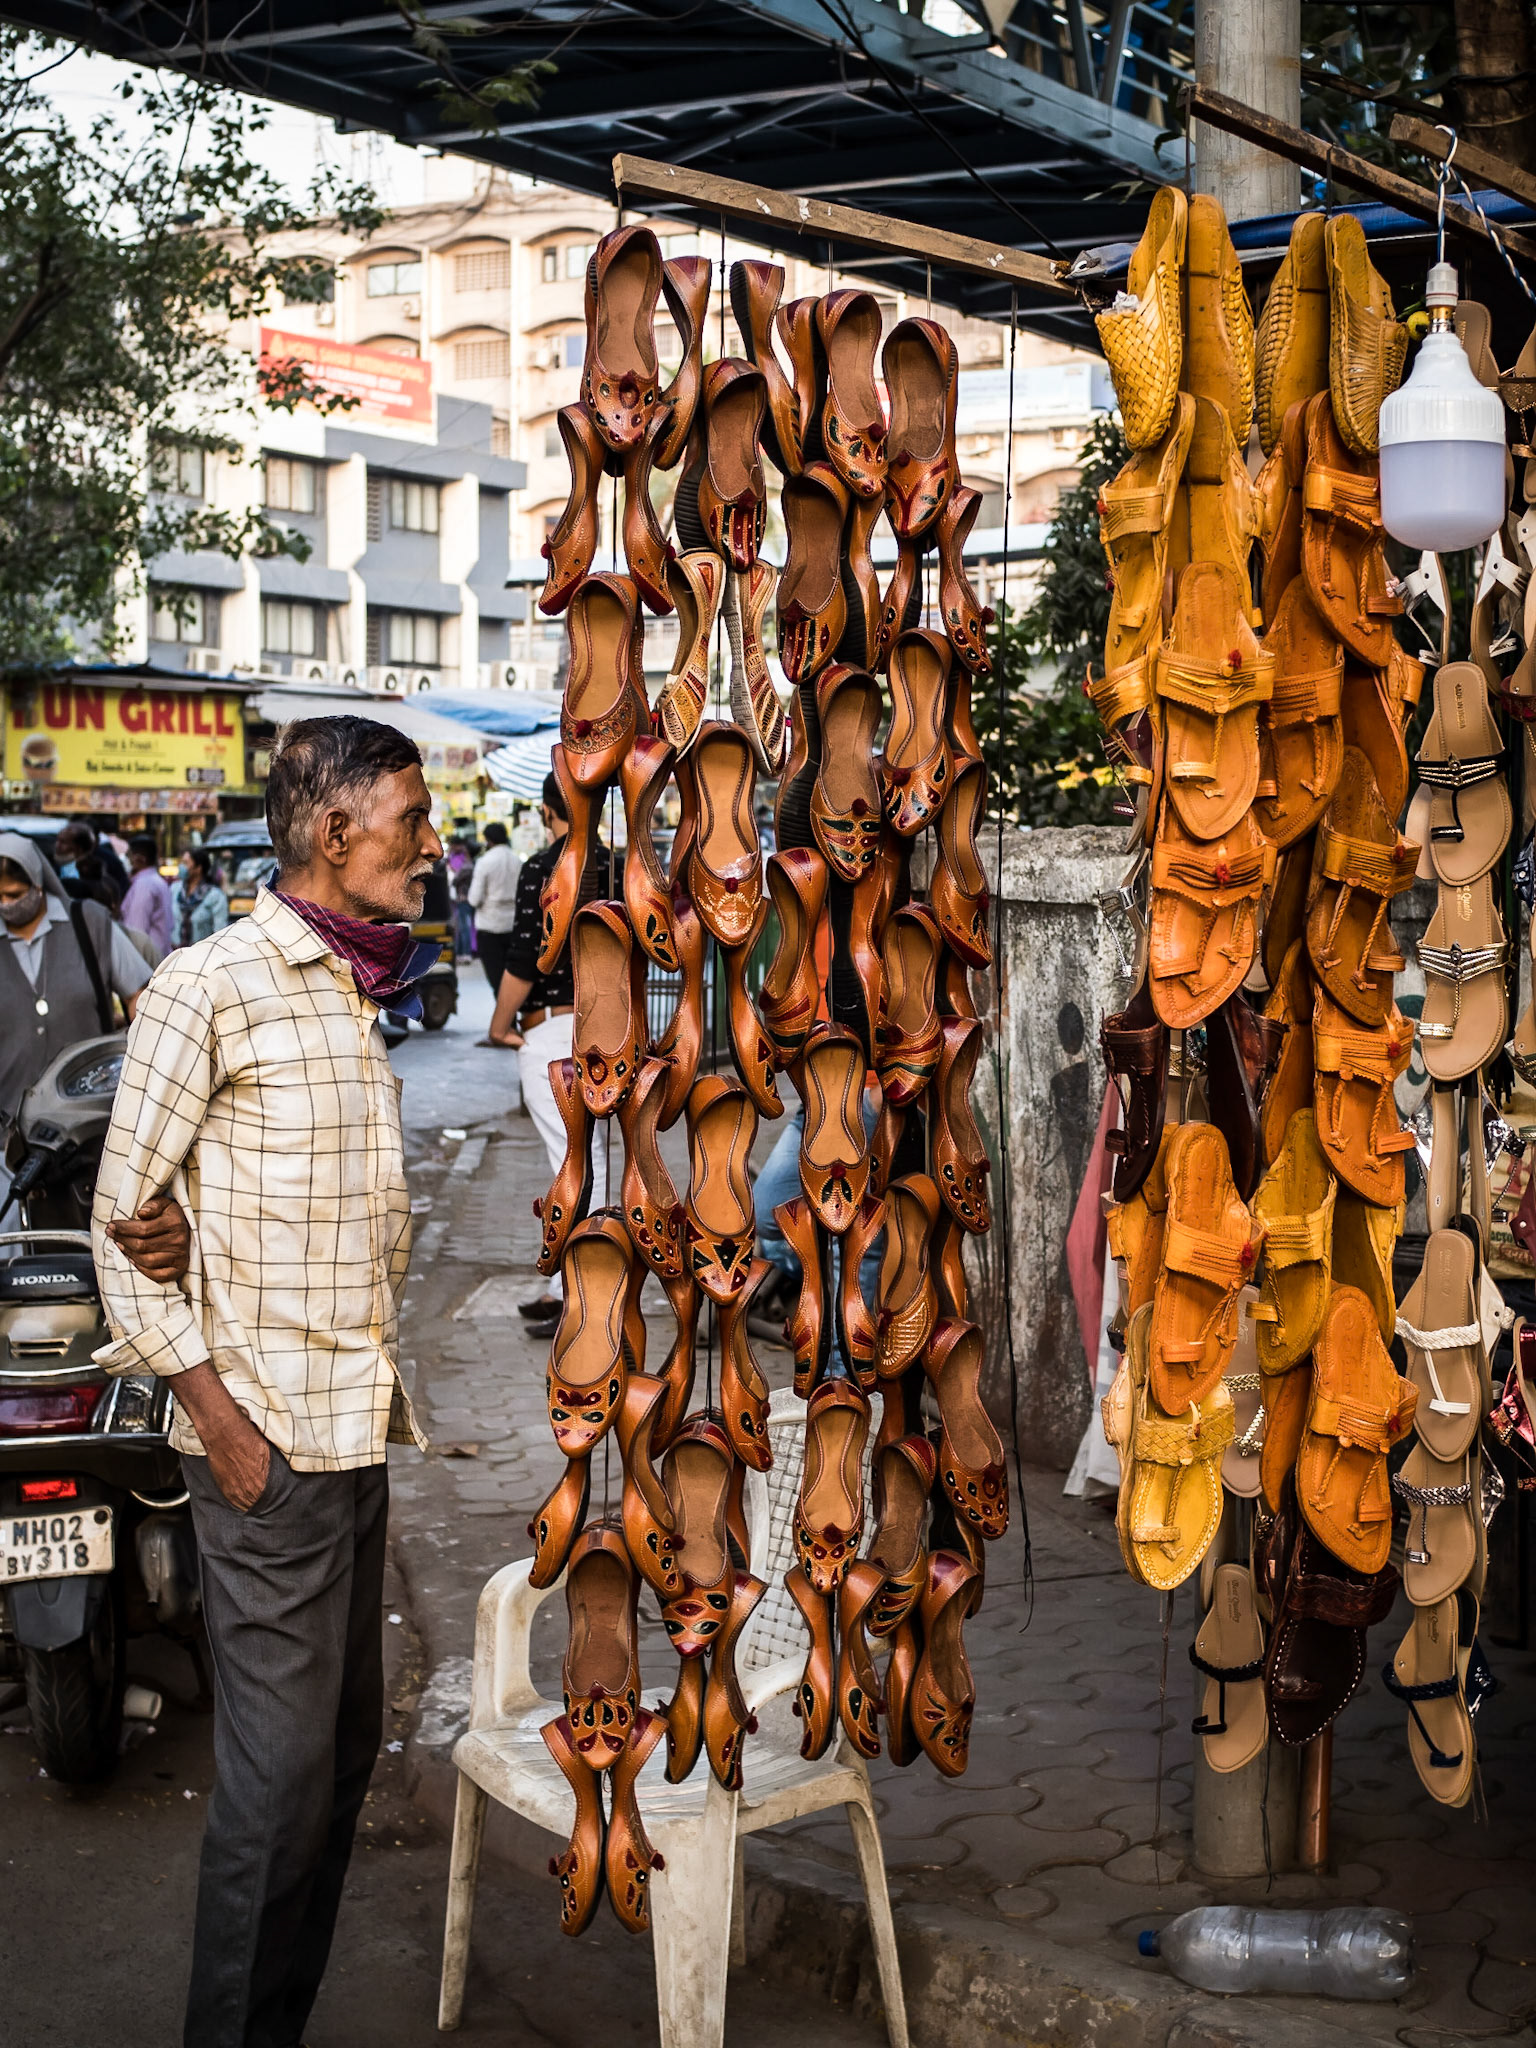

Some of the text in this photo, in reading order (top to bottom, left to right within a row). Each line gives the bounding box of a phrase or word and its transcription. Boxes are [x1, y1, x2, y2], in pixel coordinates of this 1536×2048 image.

[13, 684, 234, 737] UN GRILL
[11, 1273, 80, 1286] HONDA
[13, 1515, 83, 1546] MH02
